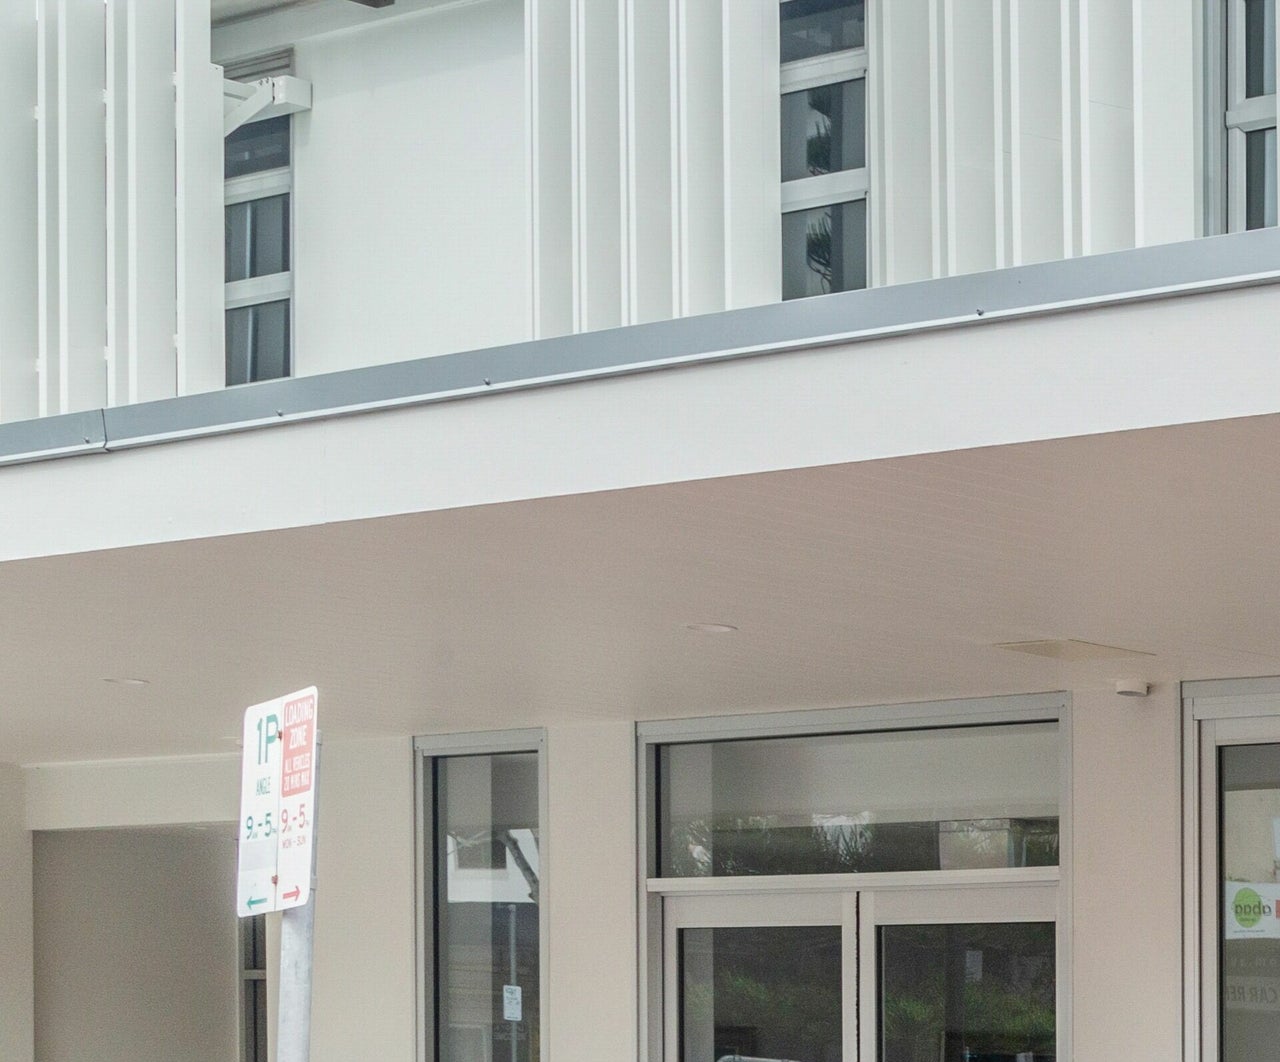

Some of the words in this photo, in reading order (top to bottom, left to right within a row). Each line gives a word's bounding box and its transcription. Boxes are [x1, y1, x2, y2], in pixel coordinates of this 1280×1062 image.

[284, 699, 314, 728] LOADING
[257, 713, 279, 765] 1P
[289, 724, 307, 750] ZONE
